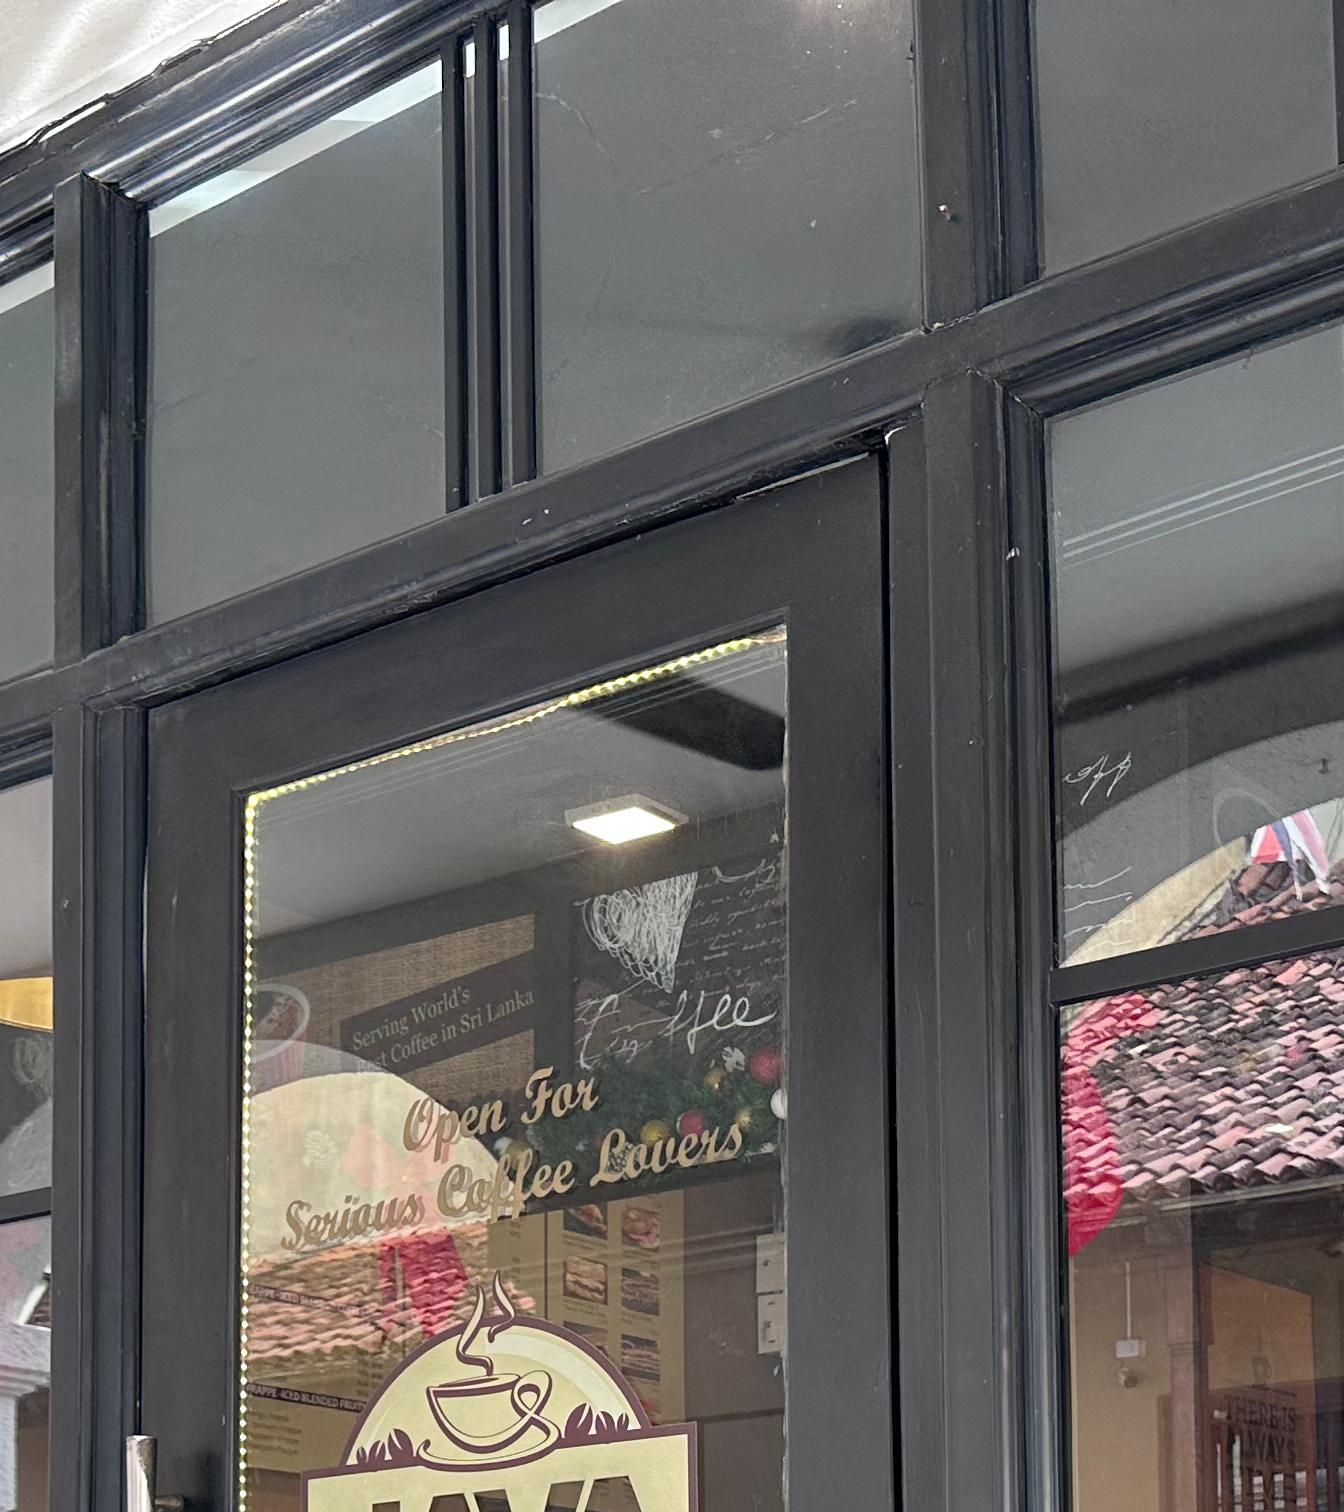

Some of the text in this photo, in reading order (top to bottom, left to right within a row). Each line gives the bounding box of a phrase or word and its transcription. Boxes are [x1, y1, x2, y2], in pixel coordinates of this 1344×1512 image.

[352, 985, 471, 1050] Serving World's
[390, 1032, 439, 1064] Coffee
[442, 1022, 457, 1043] in
[460, 1007, 484, 1034] Sri
[487, 990, 535, 1023] Lanka
[403, 1066, 600, 1162] Open For
[280, 1116, 745, 1252] Serious Coffee Lovers
